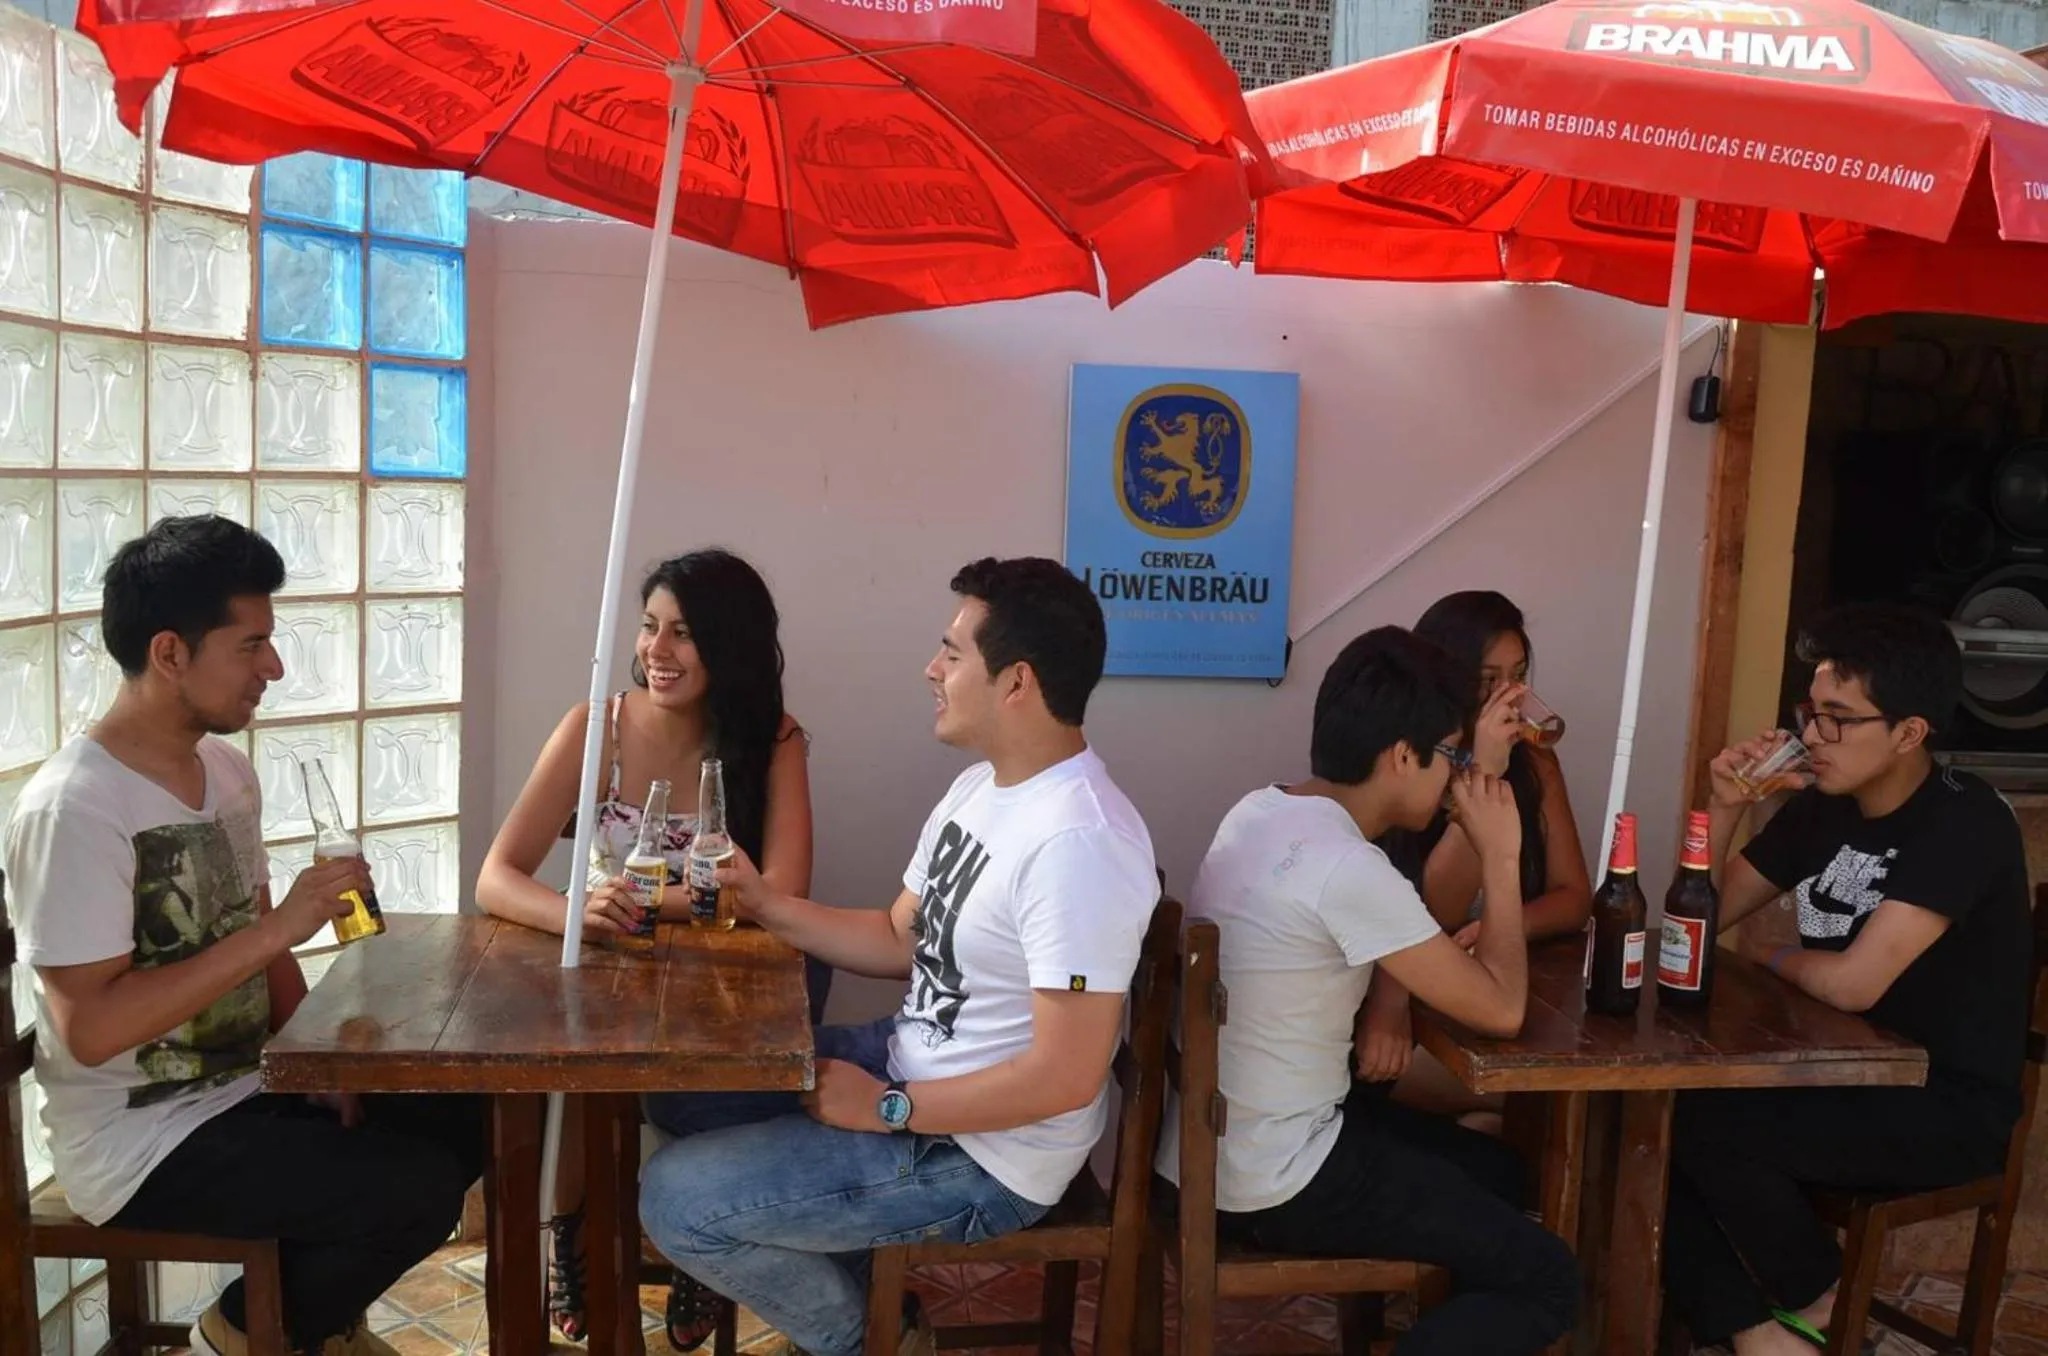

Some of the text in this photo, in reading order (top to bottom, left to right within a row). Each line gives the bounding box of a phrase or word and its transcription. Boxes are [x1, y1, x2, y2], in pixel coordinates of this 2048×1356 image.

[1584, 23, 1855, 71] BRAHMA
[1484, 104, 1935, 193] TOMAR BEBIDAS ALCOHÓLICAS EN EXCESO ES DAÑINO
[1141, 551, 1216, 569] CERVEZA
